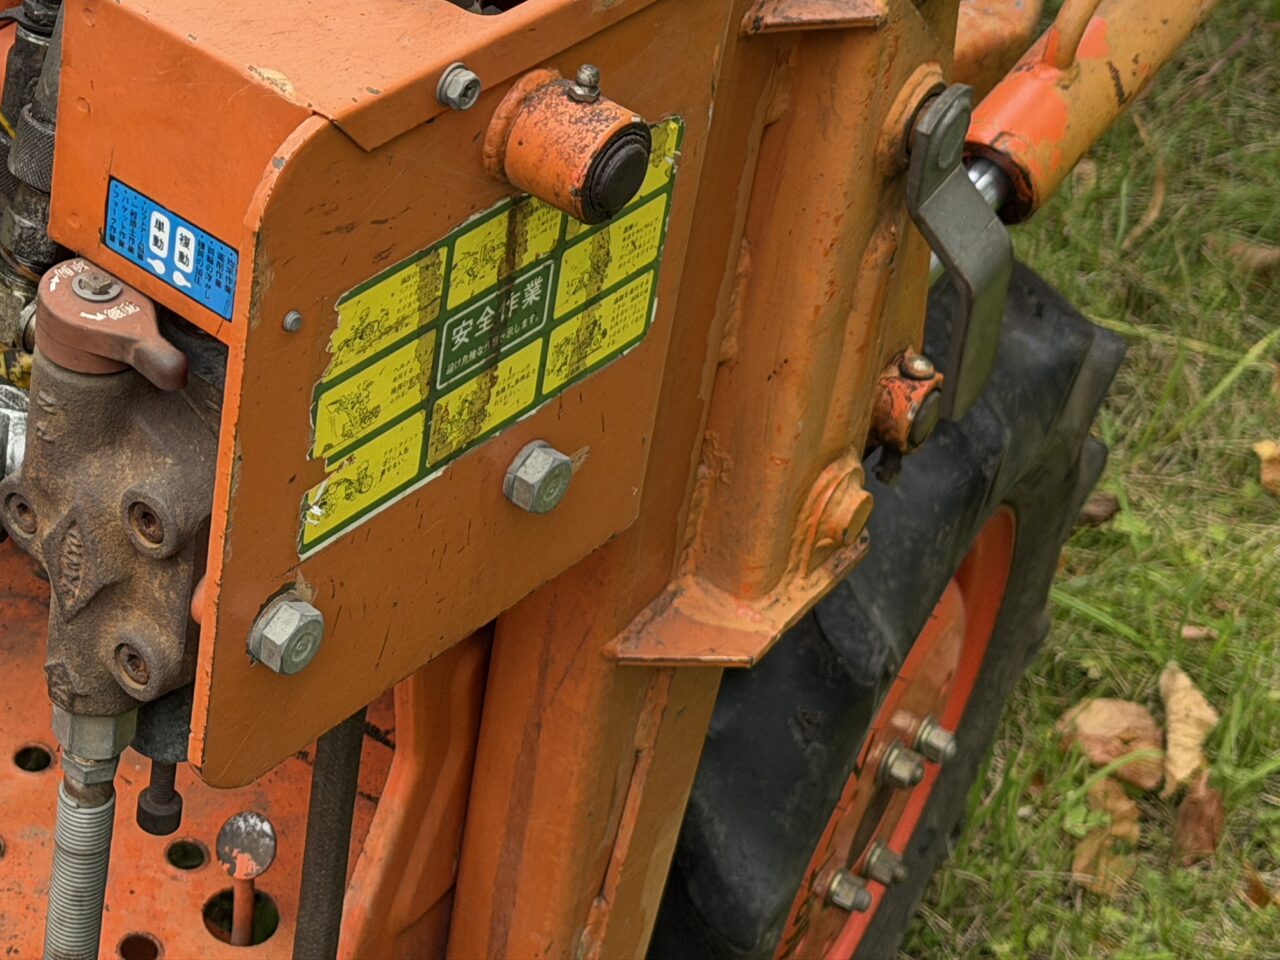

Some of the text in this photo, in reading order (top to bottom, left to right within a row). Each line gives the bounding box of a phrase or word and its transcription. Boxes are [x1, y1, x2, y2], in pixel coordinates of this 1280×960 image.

[152, 218, 165, 251] 単動
[177, 233, 191, 268] 複動
[451, 276, 543, 351] 安全作業
